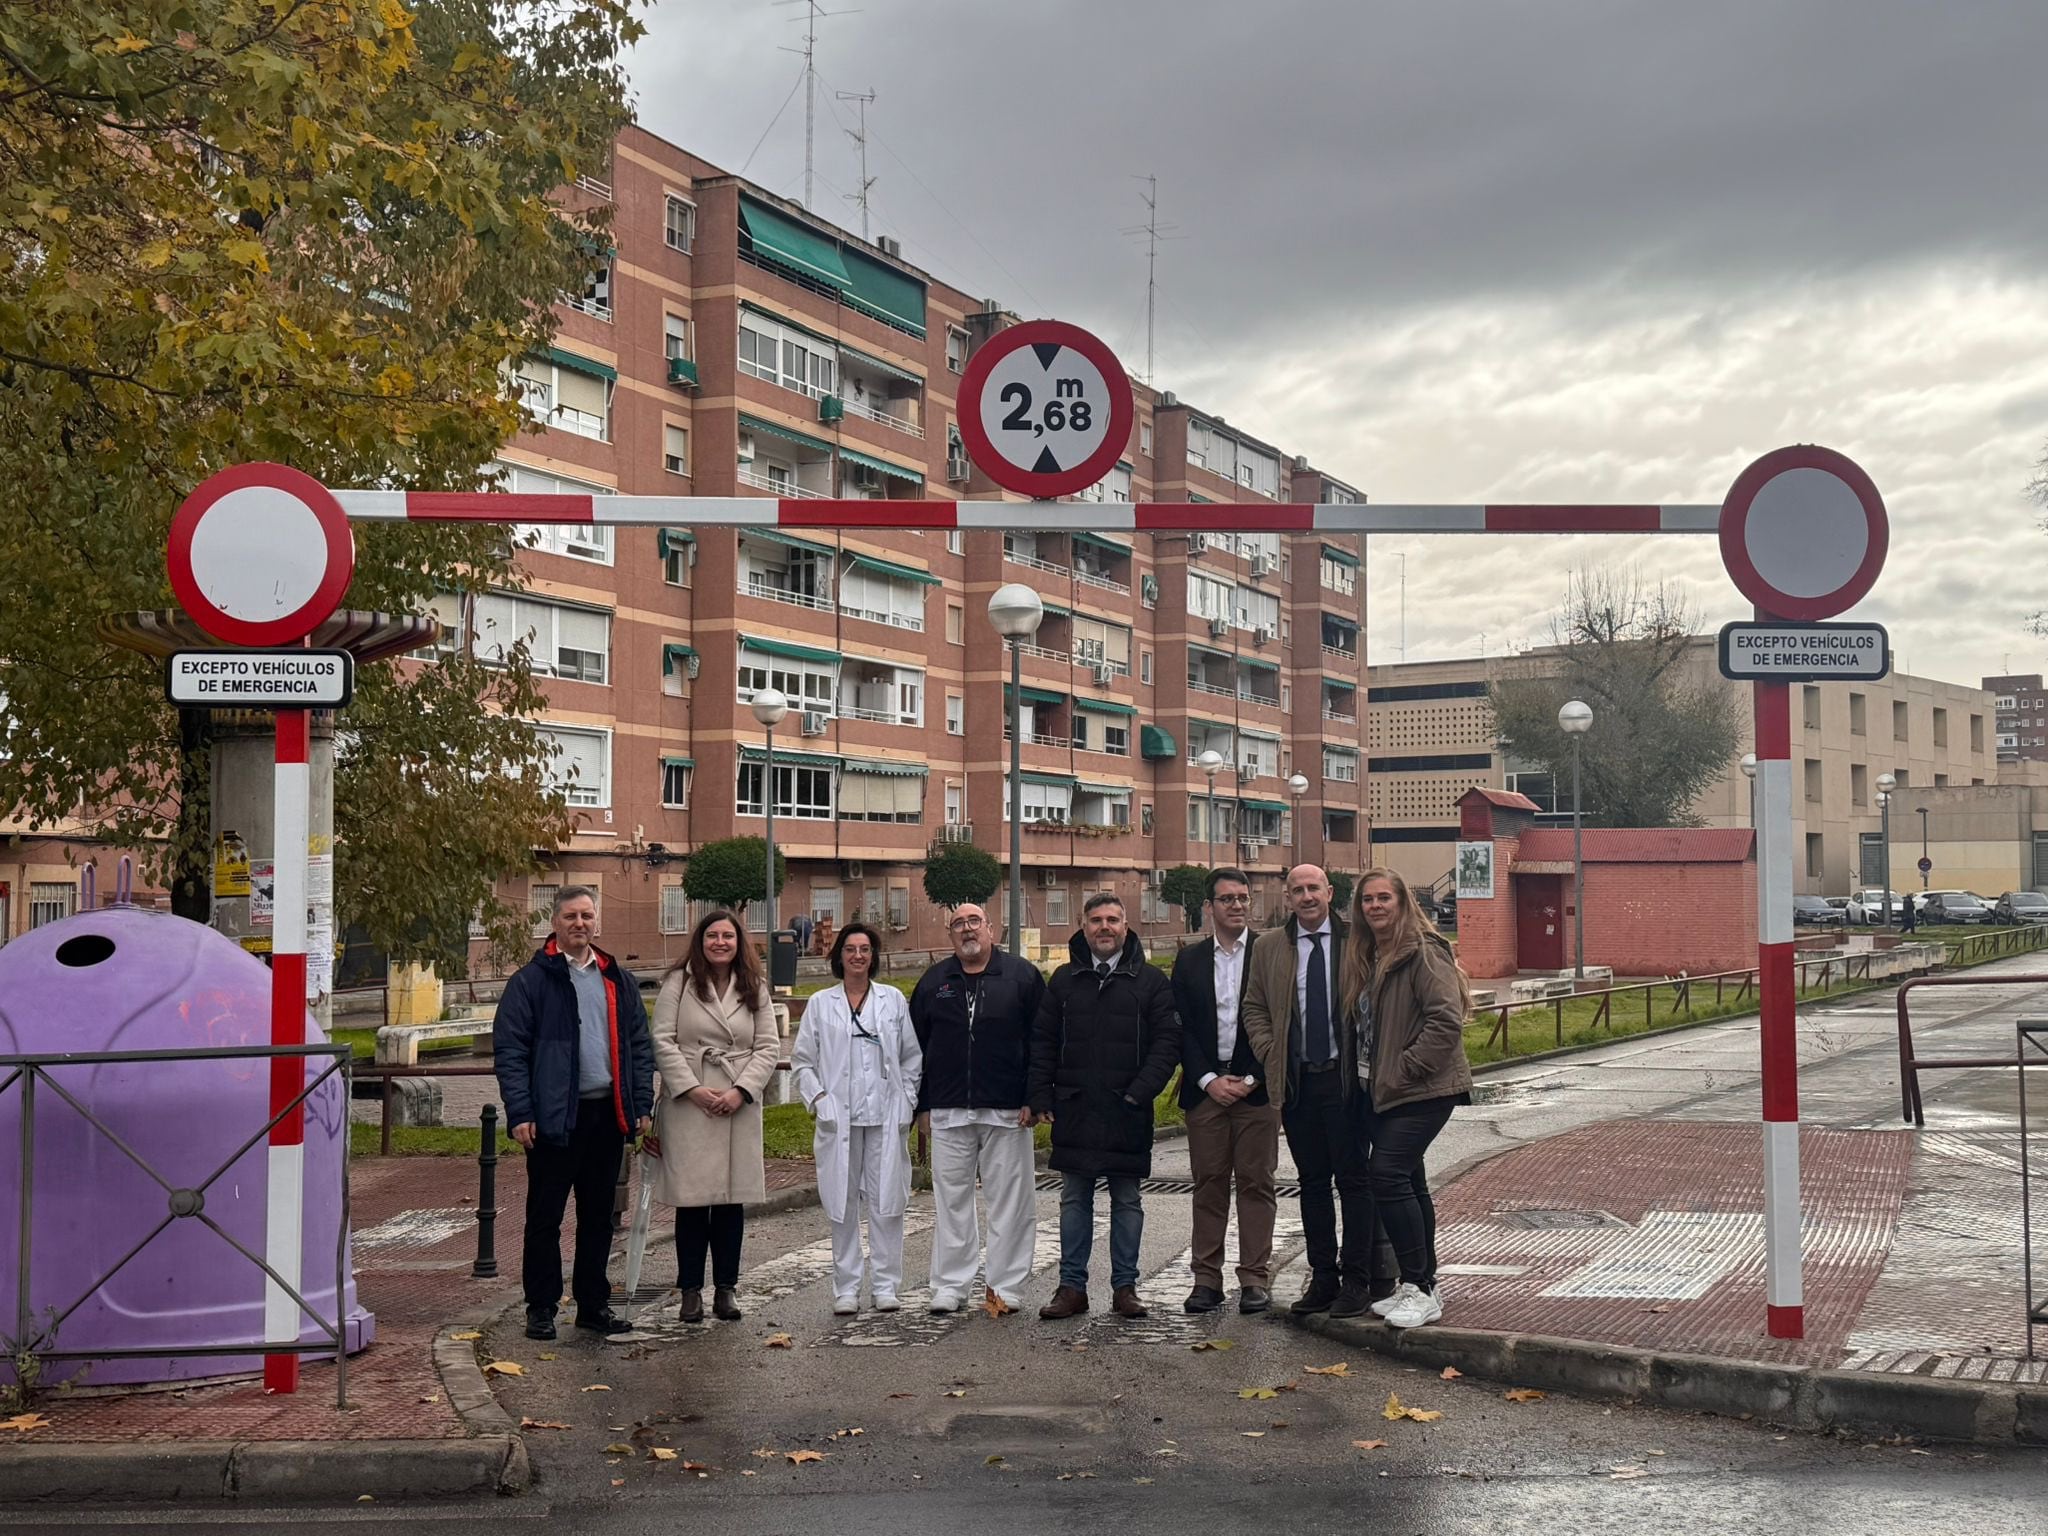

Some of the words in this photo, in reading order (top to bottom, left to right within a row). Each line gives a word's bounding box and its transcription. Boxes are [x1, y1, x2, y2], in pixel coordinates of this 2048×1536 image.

[1056, 378, 1084, 398] m
[1000, 382, 1092, 438] 2,68
[1737, 635, 1797, 648] EXCEPTO
[1800, 633, 1874, 649] VEHÍCULOS
[181, 661, 248, 675] EXCEPTO
[252, 659, 335, 676] VEHÍCULOS
[1752, 653, 1770, 666] DE
[1774, 653, 1859, 667] EMERGENCIA
[198, 679, 217, 692] DE
[222, 680, 318, 694] EMERGENCIA
